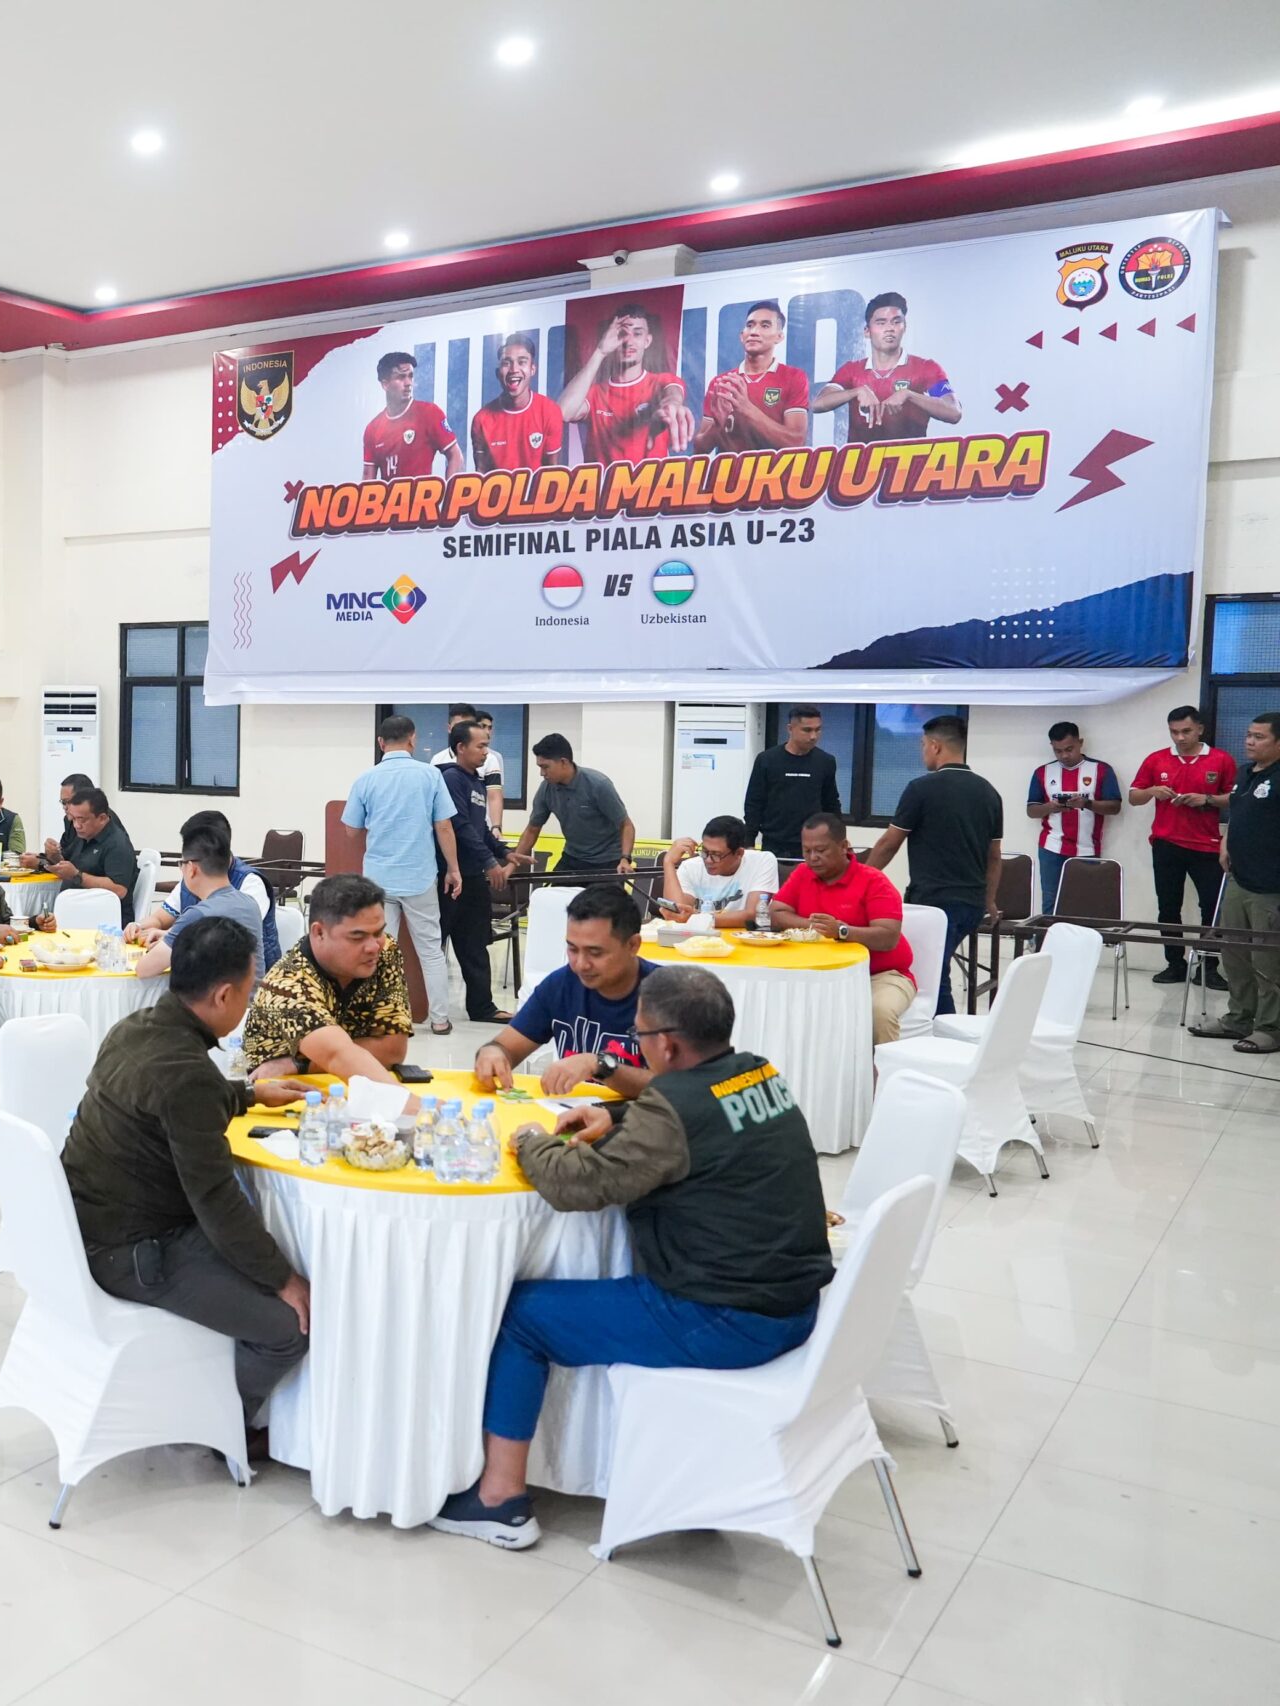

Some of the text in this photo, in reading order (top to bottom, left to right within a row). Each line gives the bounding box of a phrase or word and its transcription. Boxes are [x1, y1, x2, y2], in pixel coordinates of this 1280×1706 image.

[1059, 244, 1110, 258] MALUKU UTARA
[243, 360, 287, 373] INDONESIA
[298, 434, 1046, 531] NOBAR POLDA MALUKU UTARA
[442, 517, 816, 559] SEMIFINAL PIALA ASIA U-23
[326, 591, 385, 611] MNC
[336, 610, 373, 623] MEDIA
[535, 614, 590, 627] Indonesia
[640, 612, 708, 625] Uzbekistan
[719, 1075, 795, 1134] POLIC
